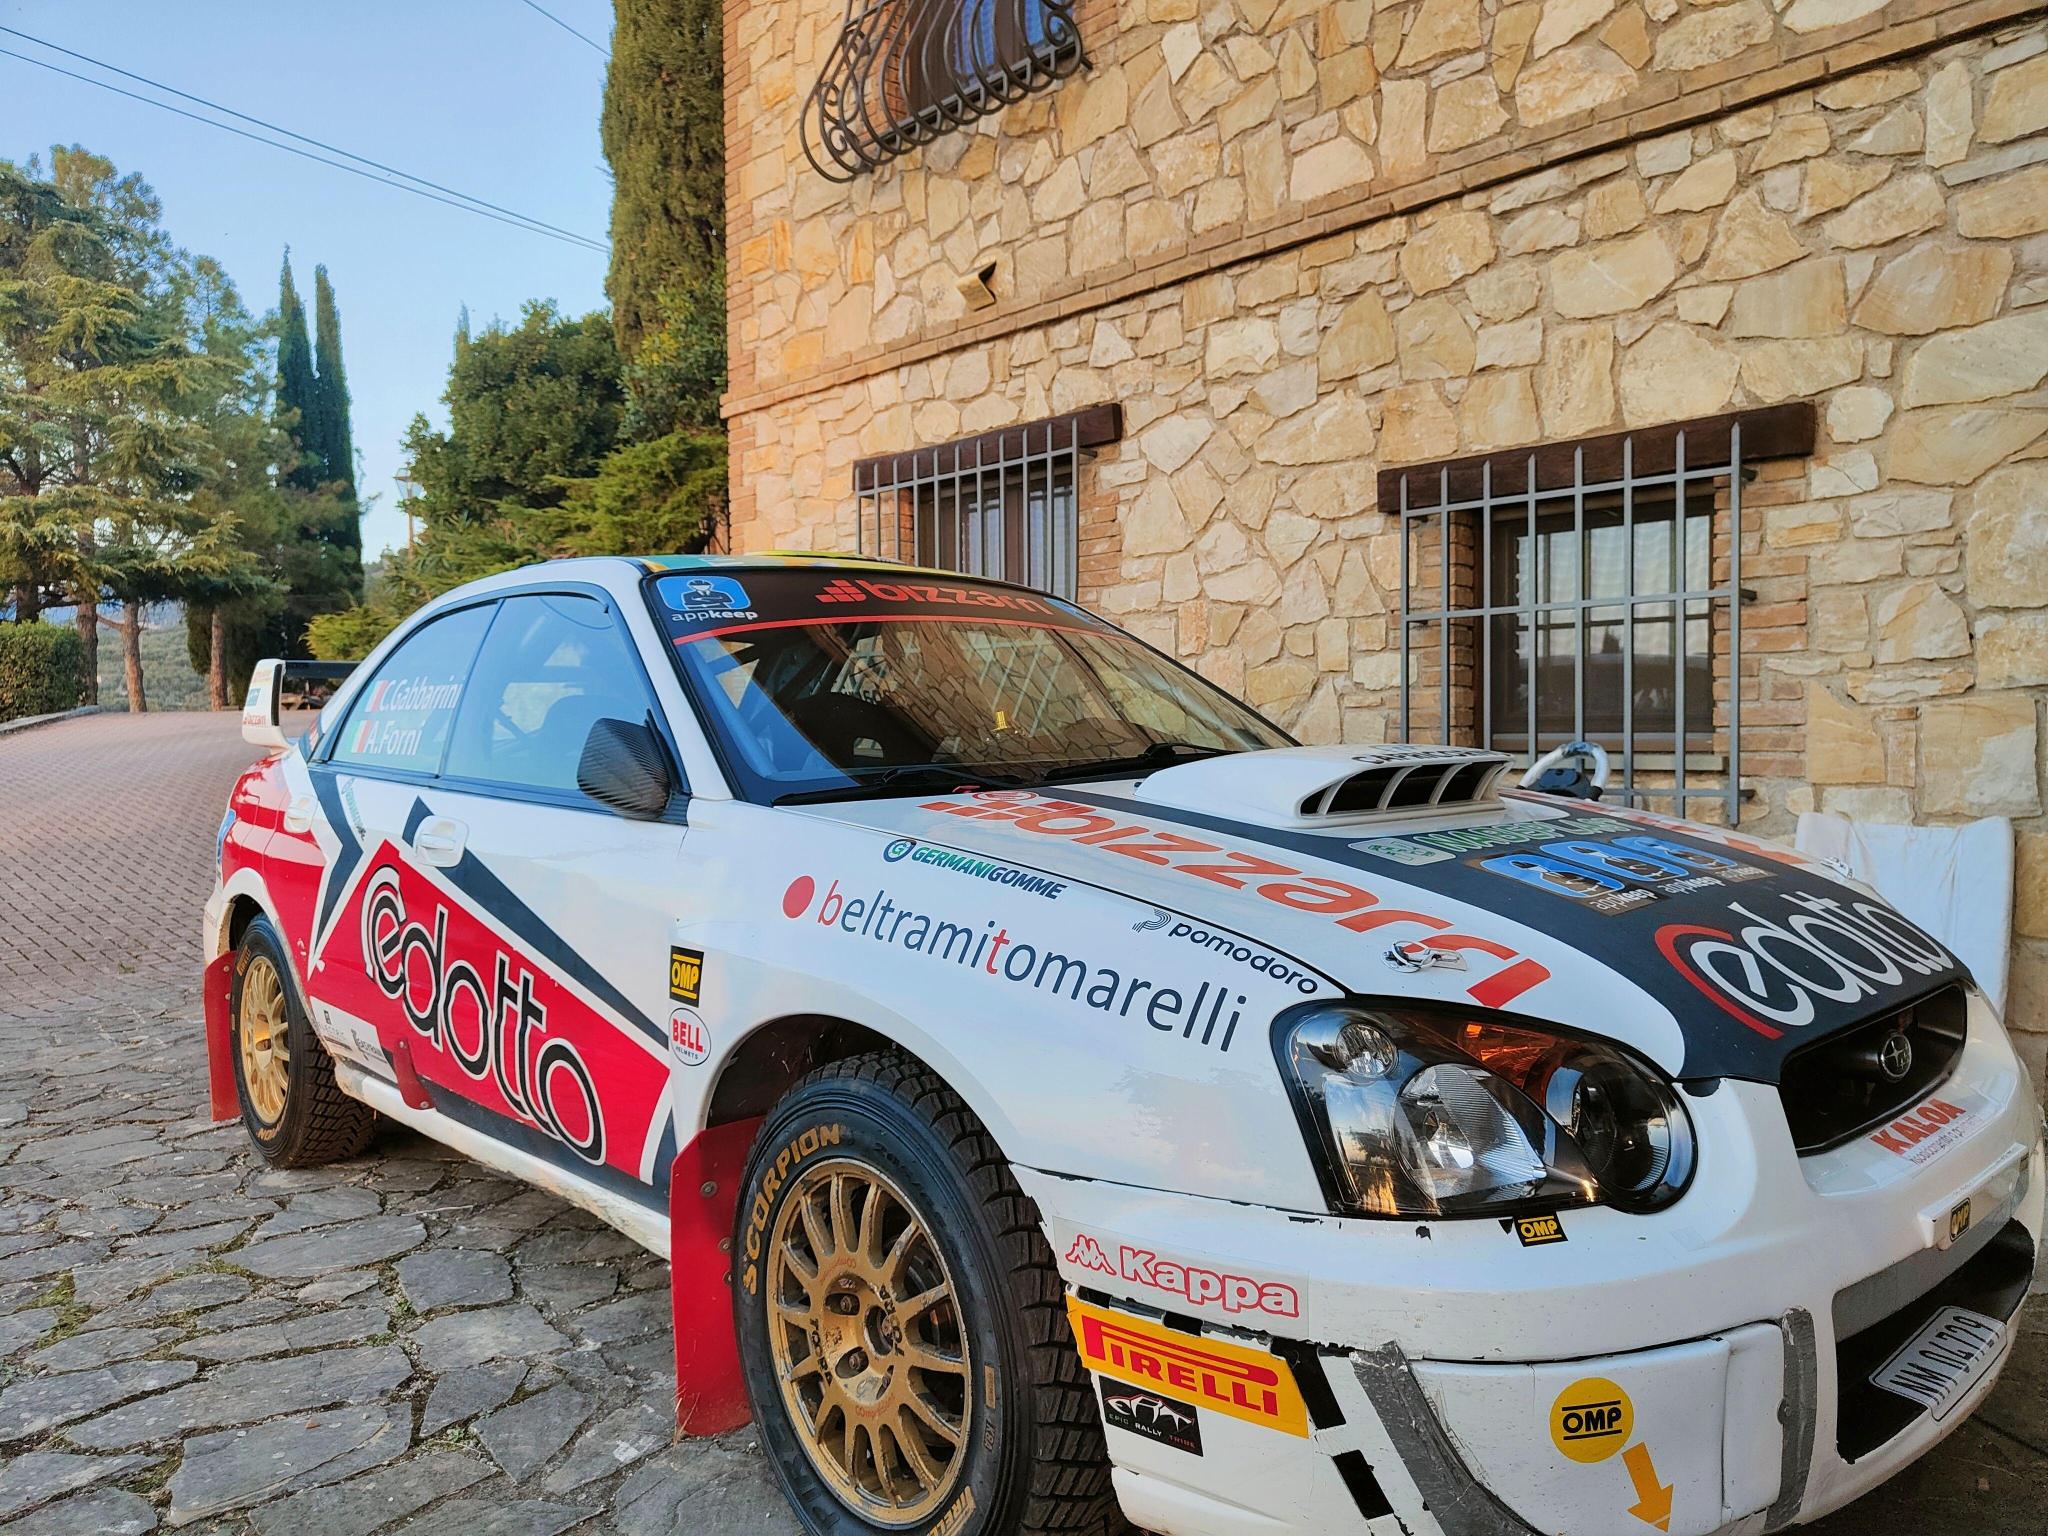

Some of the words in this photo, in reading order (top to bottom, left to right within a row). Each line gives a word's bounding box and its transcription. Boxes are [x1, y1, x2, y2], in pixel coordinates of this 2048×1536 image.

[671, 610, 759, 622] appkeep
[364, 720, 426, 756] A.Forni
[911, 845, 1069, 900] GERMANIGOMME
[1657, 876, 1727, 895] appkeep
[1589, 888, 1658, 911] appkeep
[671, 963, 700, 991] OMP
[817, 879, 1247, 1052] beltramitomarelli
[1167, 922, 1319, 995] pomodoro
[1689, 890, 1954, 1027] edotto
[672, 1018, 704, 1053] BELL
[675, 1045, 700, 1060] HELMETS
[1870, 1098, 1967, 1156] KALOA
[743, 1122, 843, 1297] SCORPION
[1520, 1218, 1558, 1237] OMP
[1119, 1245, 1300, 1318] Kappa
[1918, 1315, 2000, 1374] 04729
[1081, 1314, 1280, 1417] PIRELLI
[1889, 1362, 1959, 1405] NM
[1108, 1413, 1129, 1426] EPIC
[1134, 1422, 1162, 1437] RALLY
[1562, 1407, 1623, 1434] OMP
